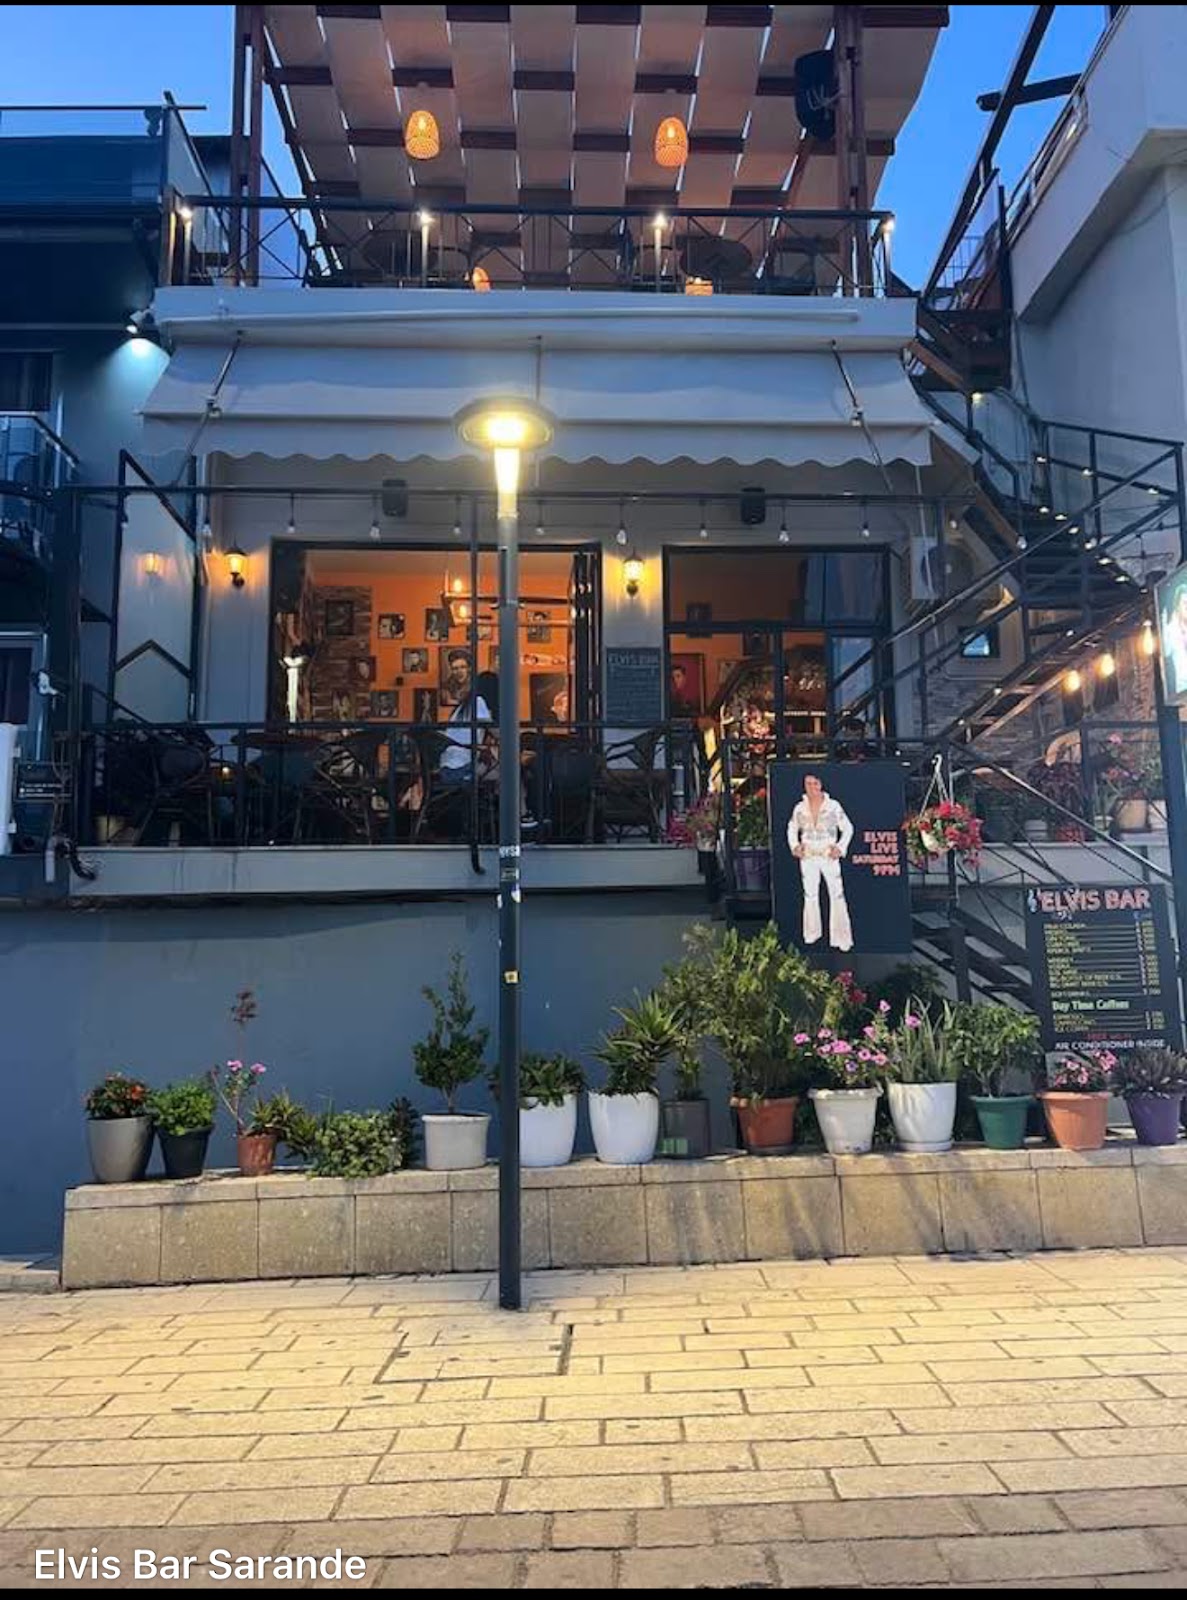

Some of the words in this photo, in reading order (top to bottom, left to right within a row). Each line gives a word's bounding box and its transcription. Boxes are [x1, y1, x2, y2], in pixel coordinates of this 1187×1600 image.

[864, 831, 898, 842] ELVIS
[870, 842, 899, 854] LIVE
[852, 854, 899, 864] SATURDAY
[1040, 889, 1100, 912] ELVIS
[1104, 888, 1151, 910] BAR
[1052, 1000, 1070, 1012] Day
[1072, 1000, 1095, 1011] Time
[1096, 999, 1130, 1011] Coffees
[1055, 1041, 1070, 1050] AIR
[1071, 1040, 1135, 1050] CONDITIONER
[1136, 1039, 1166, 1048] INSIDE
